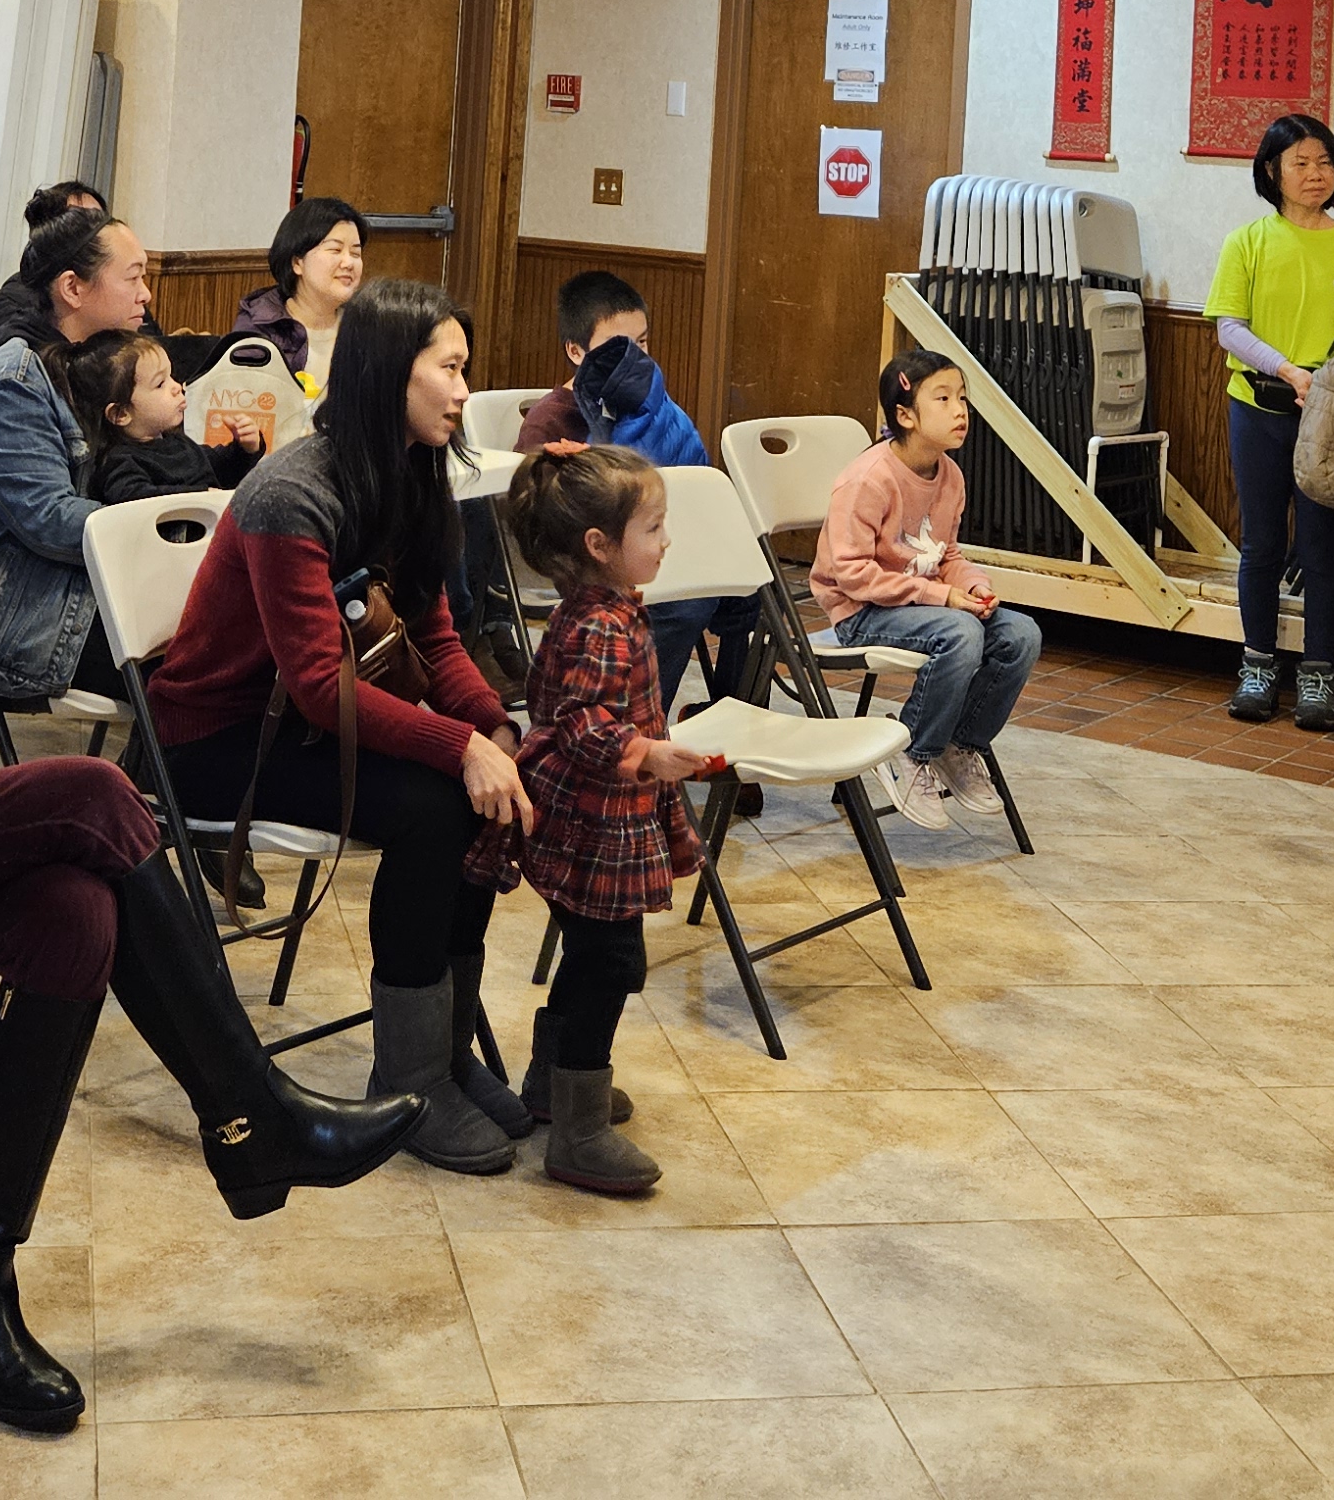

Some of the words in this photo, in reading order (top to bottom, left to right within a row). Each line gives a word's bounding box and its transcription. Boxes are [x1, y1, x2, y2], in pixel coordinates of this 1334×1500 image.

[550, 76, 572, 94] FIRE
[828, 162, 868, 183] STOP
[260, 396, 274, 407] 22
